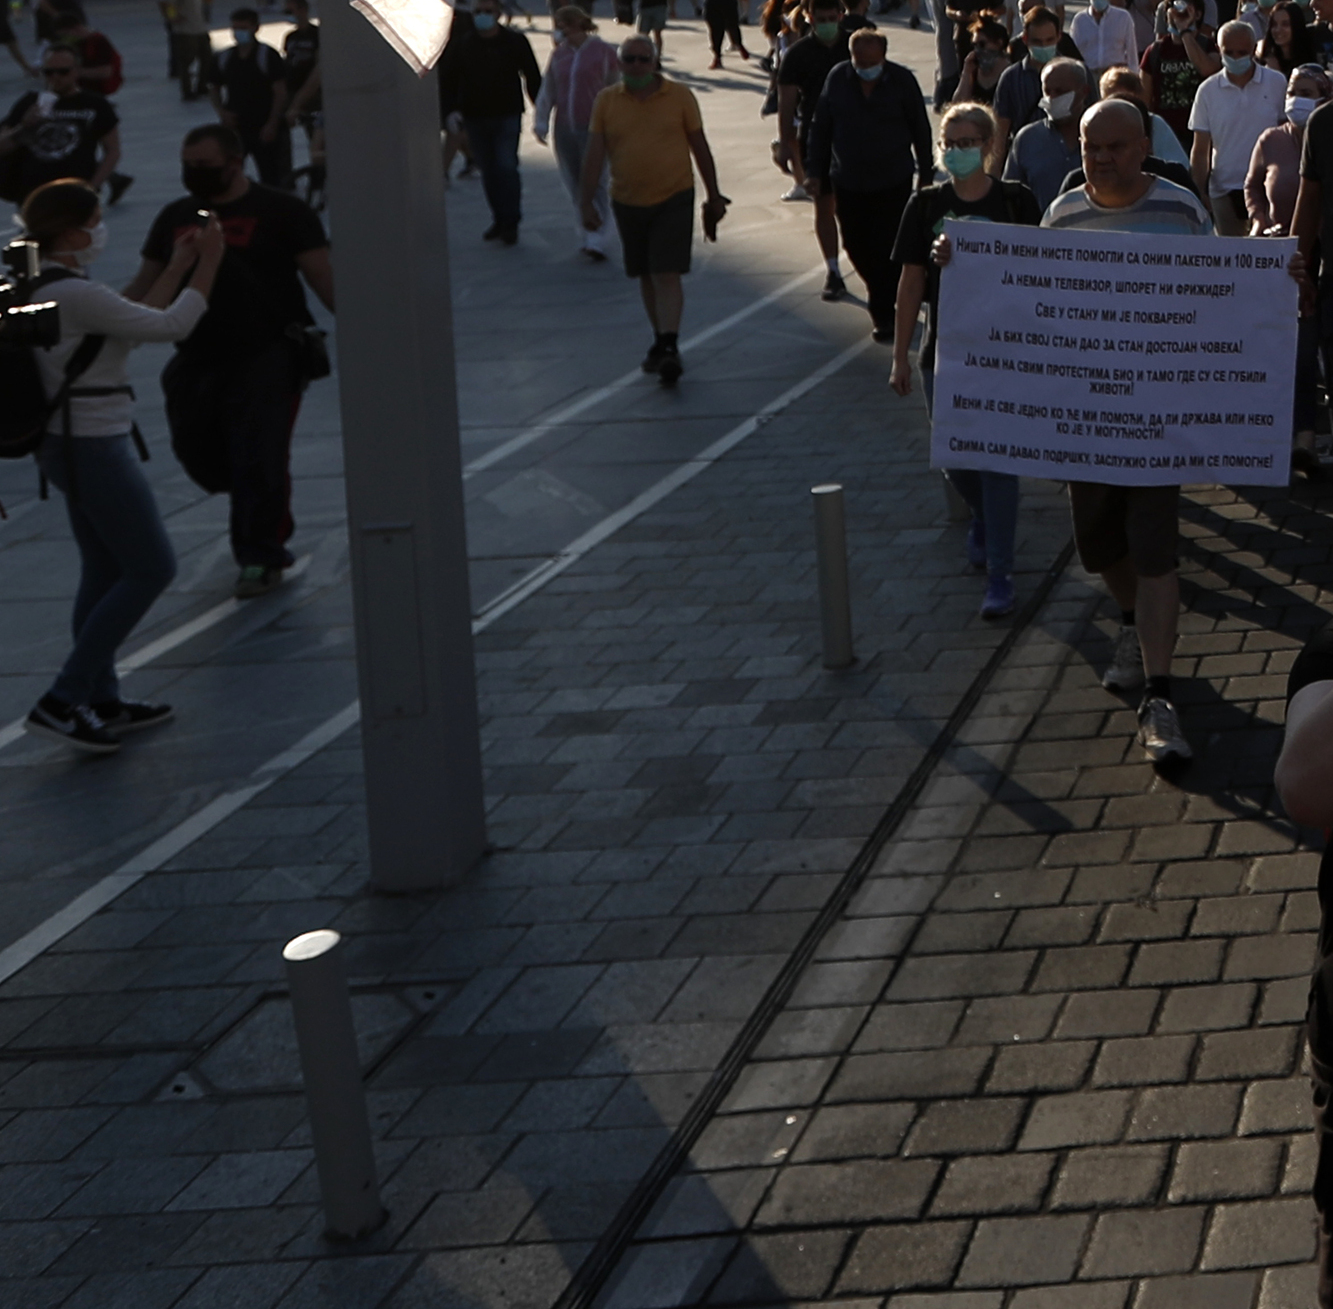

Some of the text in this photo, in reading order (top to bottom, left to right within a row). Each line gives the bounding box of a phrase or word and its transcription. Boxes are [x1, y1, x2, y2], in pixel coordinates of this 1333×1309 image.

[957, 237, 1284, 269] НИШТА ВИ МЕНИ НИСТЕ ПОМОГЛИ СА ОНИМ ПАКЕТОМ И 100 ЕВРА!
[1001, 270, 1235, 298] ЈА НЕМАМ ТЕЛЕВИЗОР, ШПОРЕТ НИ ФРИЖИДЕР!
[1035, 302, 1196, 324] СВЕ У СТАНУ МИ ЈЕ ПОКВАРЕНО!
[989, 327, 1243, 355] ЈА БИХ СВОЈ СТАН ДАО ЗА СТАН ДОСТОЈАН ЧОВЕКА!
[965, 353, 1266, 384] ЈА САМ НА СВИМ ПРОТЕСТИМА БИО И ТАМО ГДЕ СУ СЕ ГУБИЛИ
[1090, 381, 1134, 395] ЖИВОТИ!
[953, 394, 1274, 428] МЕНИ ЈЕ СВЕ ЈЕДНО КО ЋЕ МИ ПОМОЋИ, ДА ЛИ ДРЖАВА ИЛИ НЕКО
[1056, 422, 1069, 434] КО
[1072, 424, 1083, 435] ЈЕ
[1086, 425, 1092, 436] У
[949, 437, 985, 452] СВИМА
[987, 442, 1007, 455] САМ
[1009, 445, 1040, 460] ДАВАО
[1149, 456, 1170, 468] САМ
[1173, 456, 1186, 469] ДА
[1189, 456, 1204, 466] МИ
[1207, 455, 1220, 467] СЕ
